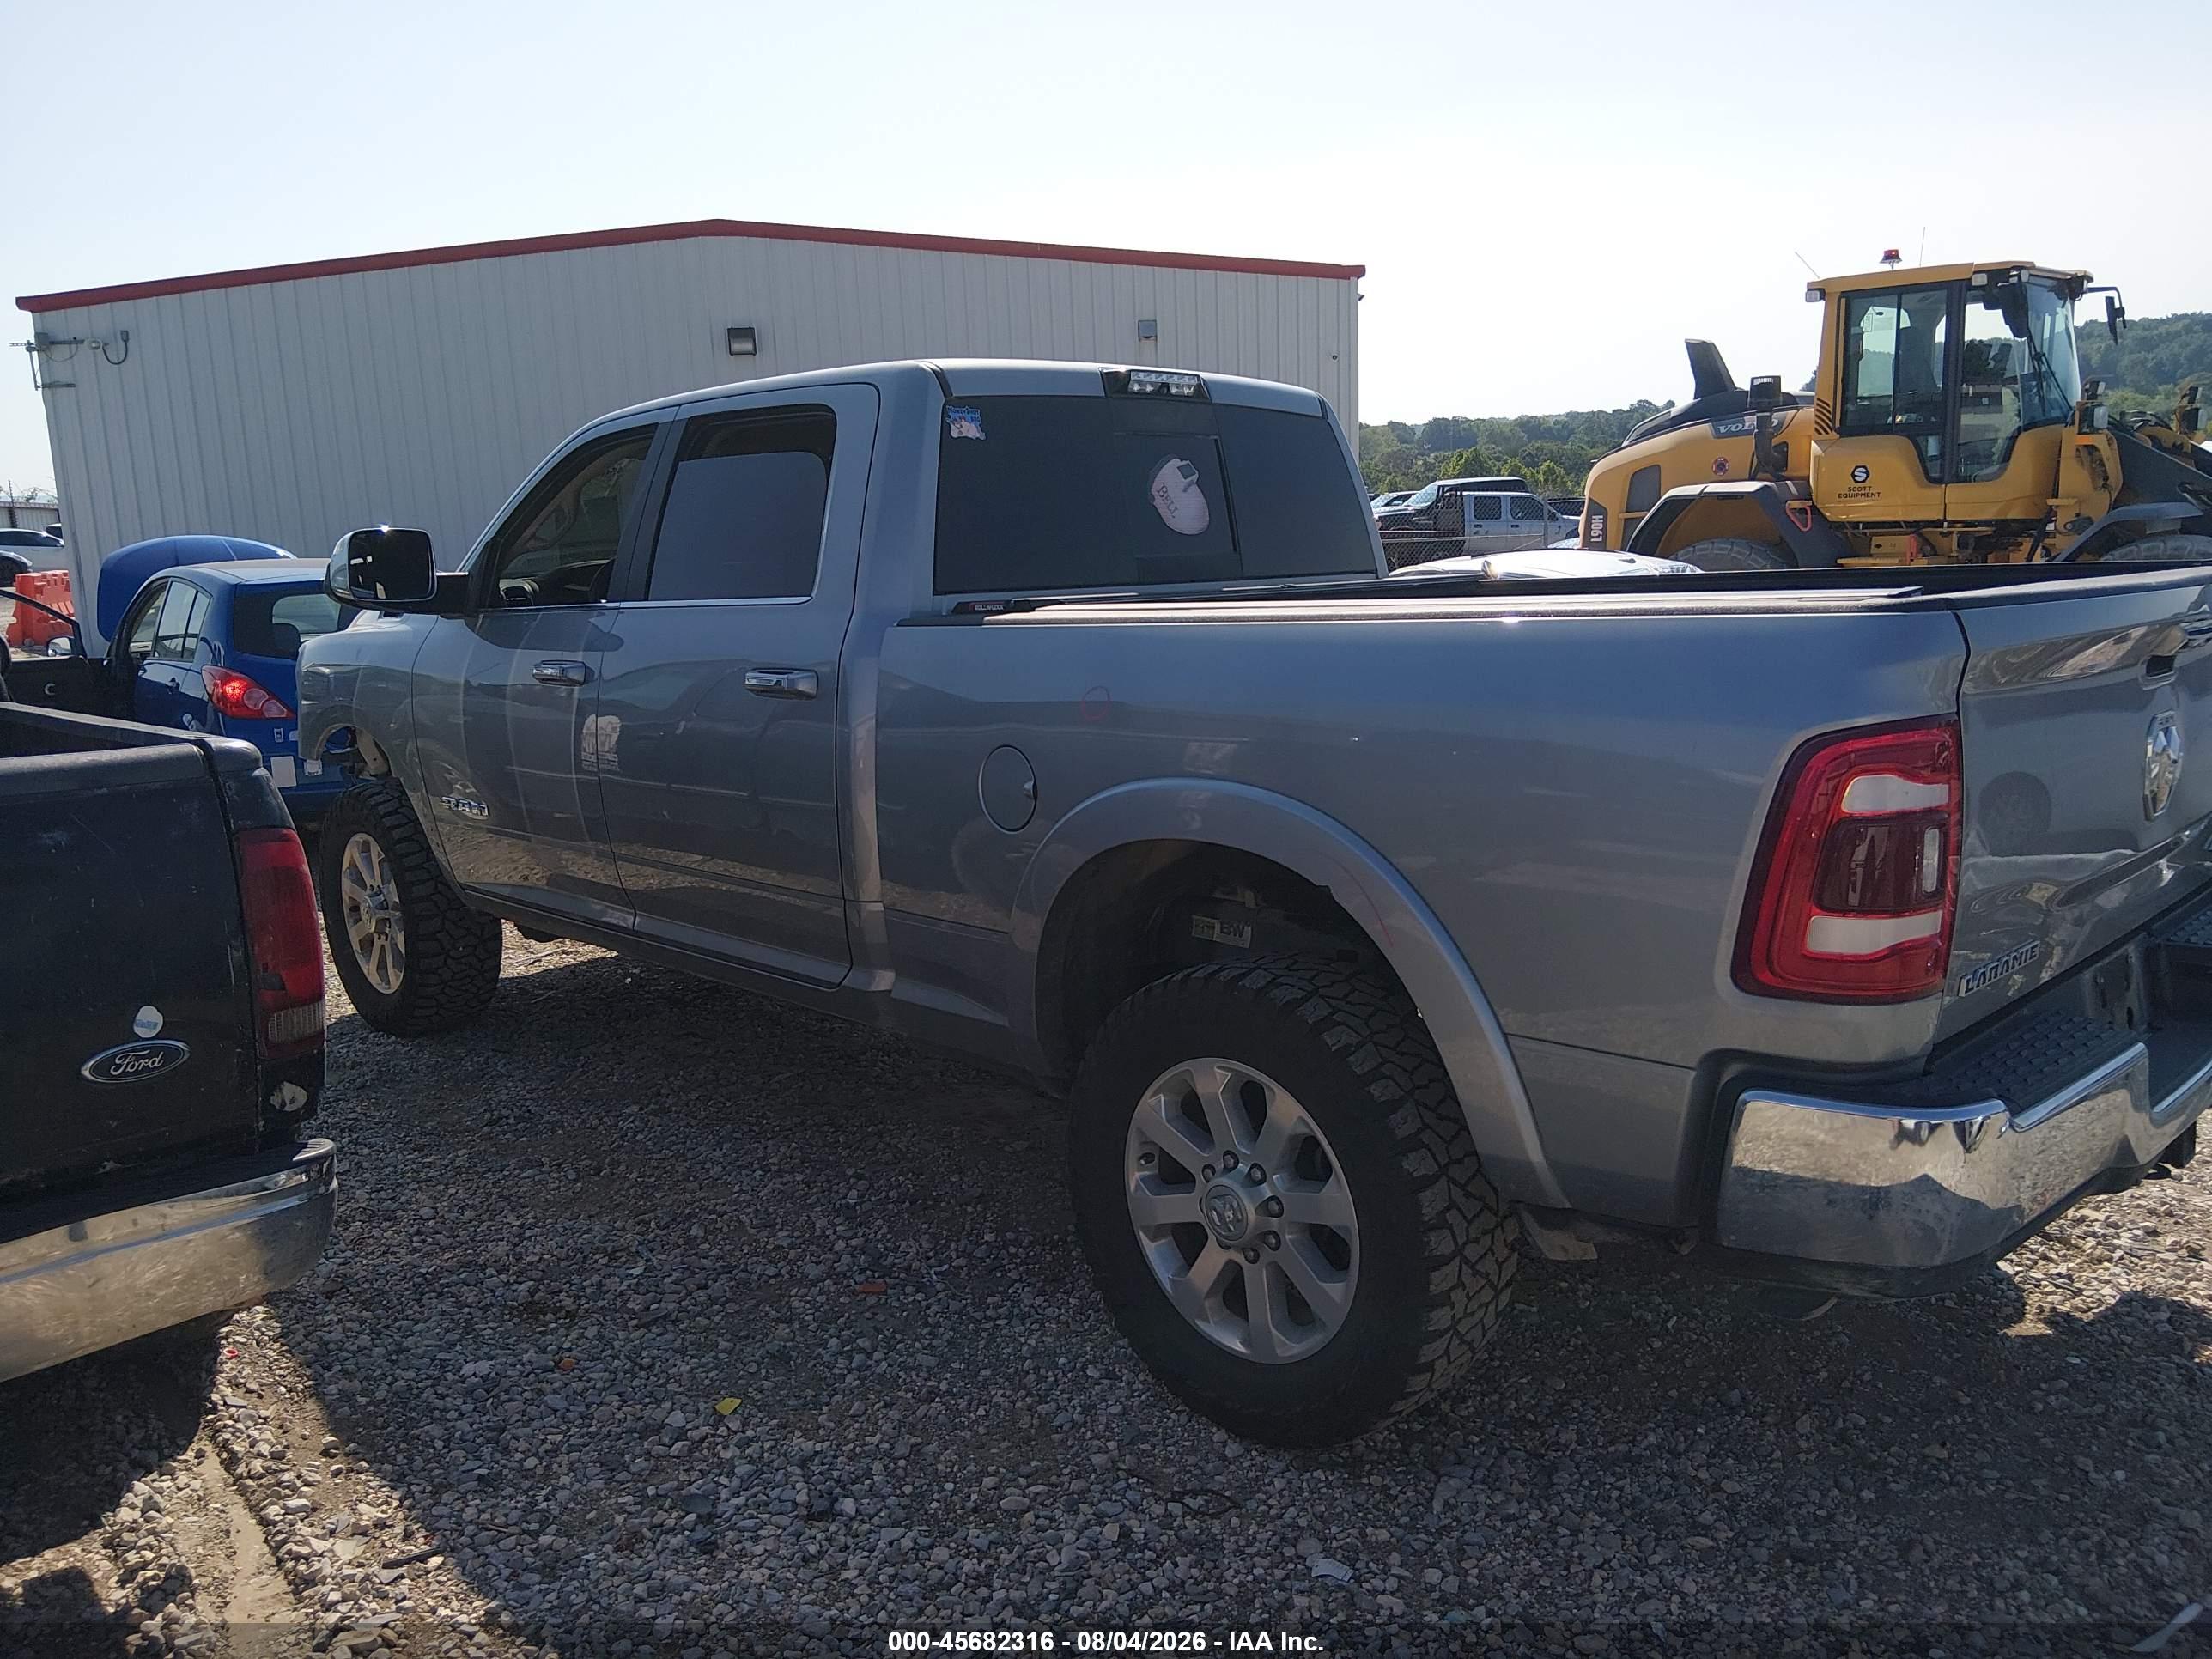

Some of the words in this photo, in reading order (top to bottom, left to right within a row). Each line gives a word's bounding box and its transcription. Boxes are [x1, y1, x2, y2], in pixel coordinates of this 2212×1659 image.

[1717, 418, 1779, 434] VOLO
[1590, 514, 1604, 542] L90H
[440, 795, 489, 817] RAM
[1958, 939, 2040, 997] LARAMIE
[110, 1049, 164, 1075] Ford
